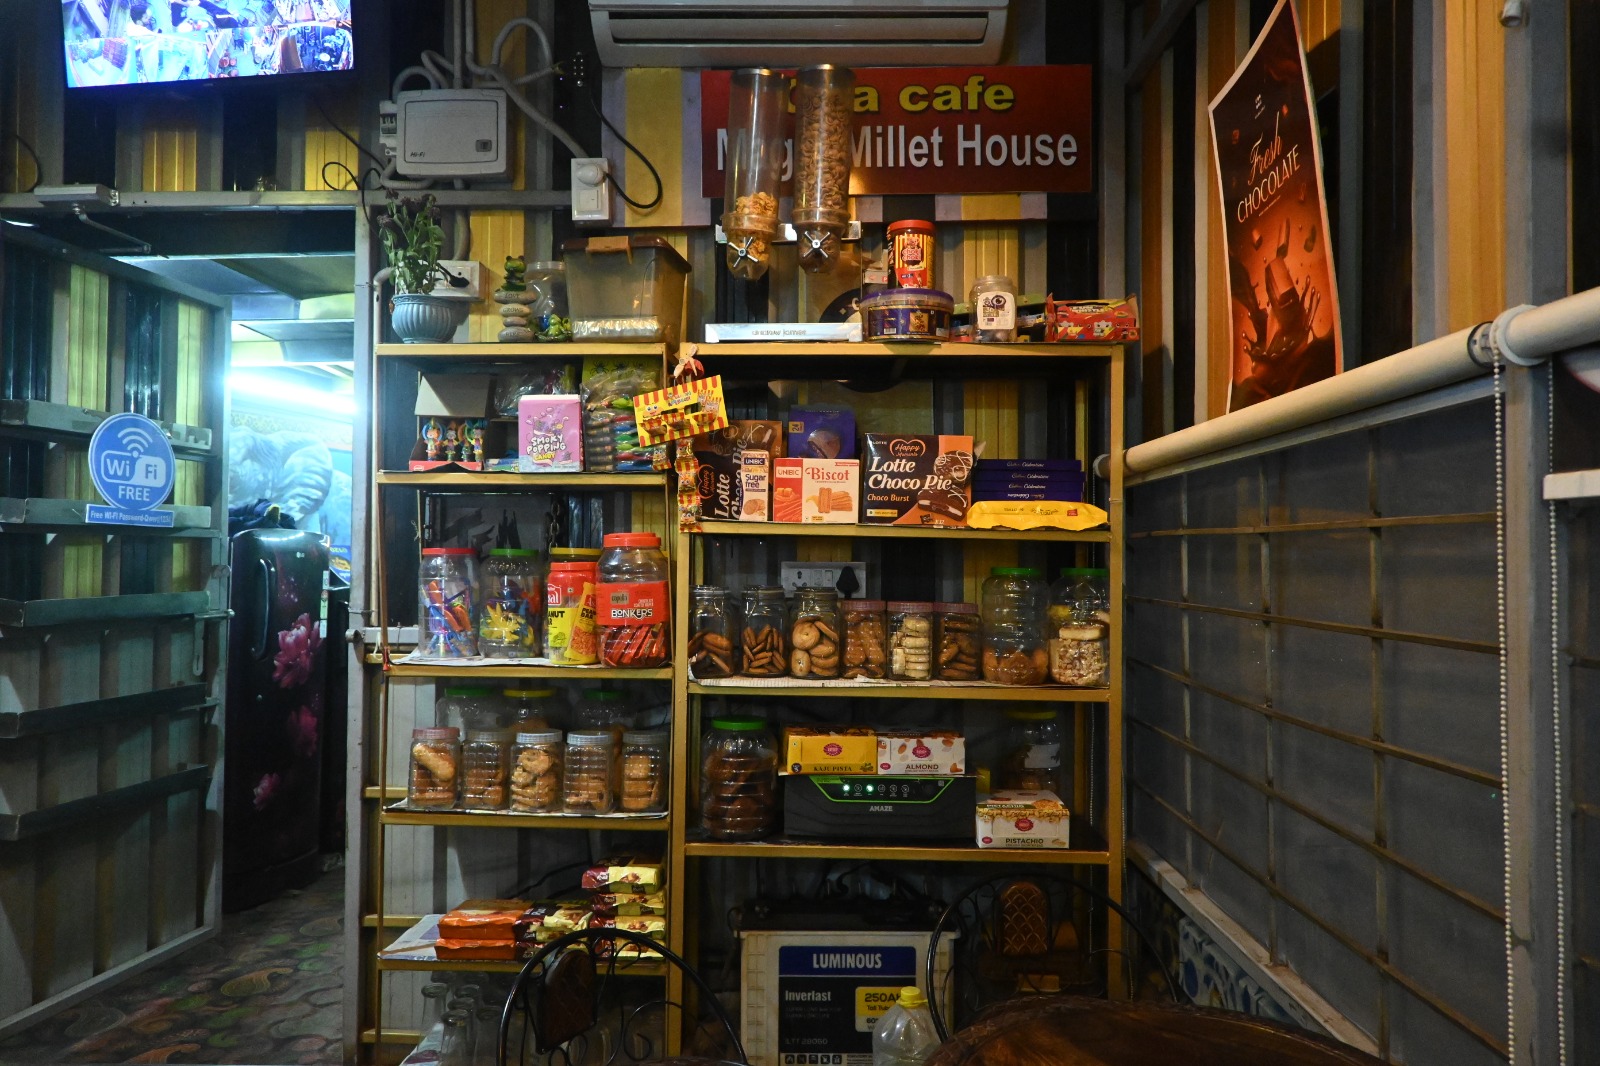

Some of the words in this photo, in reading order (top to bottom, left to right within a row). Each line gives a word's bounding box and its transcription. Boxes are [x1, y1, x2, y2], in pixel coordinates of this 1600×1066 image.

[899, 75, 1015, 112] cafe
[850, 125, 943, 168] Millet
[957, 123, 1078, 167] House
[1248, 110, 1282, 186] Fresh
[1237, 144, 1301, 223] CHOCOLATE
[531, 433, 563, 446] SMOKY
[527, 443, 566, 455] POPPING
[535, 452, 555, 460] CANDY
[745, 457, 764, 465] UNIBIC
[869, 456, 916, 473] Lotte
[106, 458, 130, 477] Wi
[145, 463, 158, 480] Fi
[804, 466, 850, 481] Biscot
[745, 473, 766, 483] Sugar
[745, 480, 760, 489] free
[868, 473, 921, 490] Choco
[922, 474, 952, 491] Pie
[118, 485, 151, 501] FREE
[714, 473, 730, 518] Lotte
[867, 493, 889, 501] Choco
[890, 494, 909, 502] Burst
[90, 511, 104, 519] Free
[611, 608, 653, 620] BONKERS
[812, 953, 882, 969] LUMINOUS
